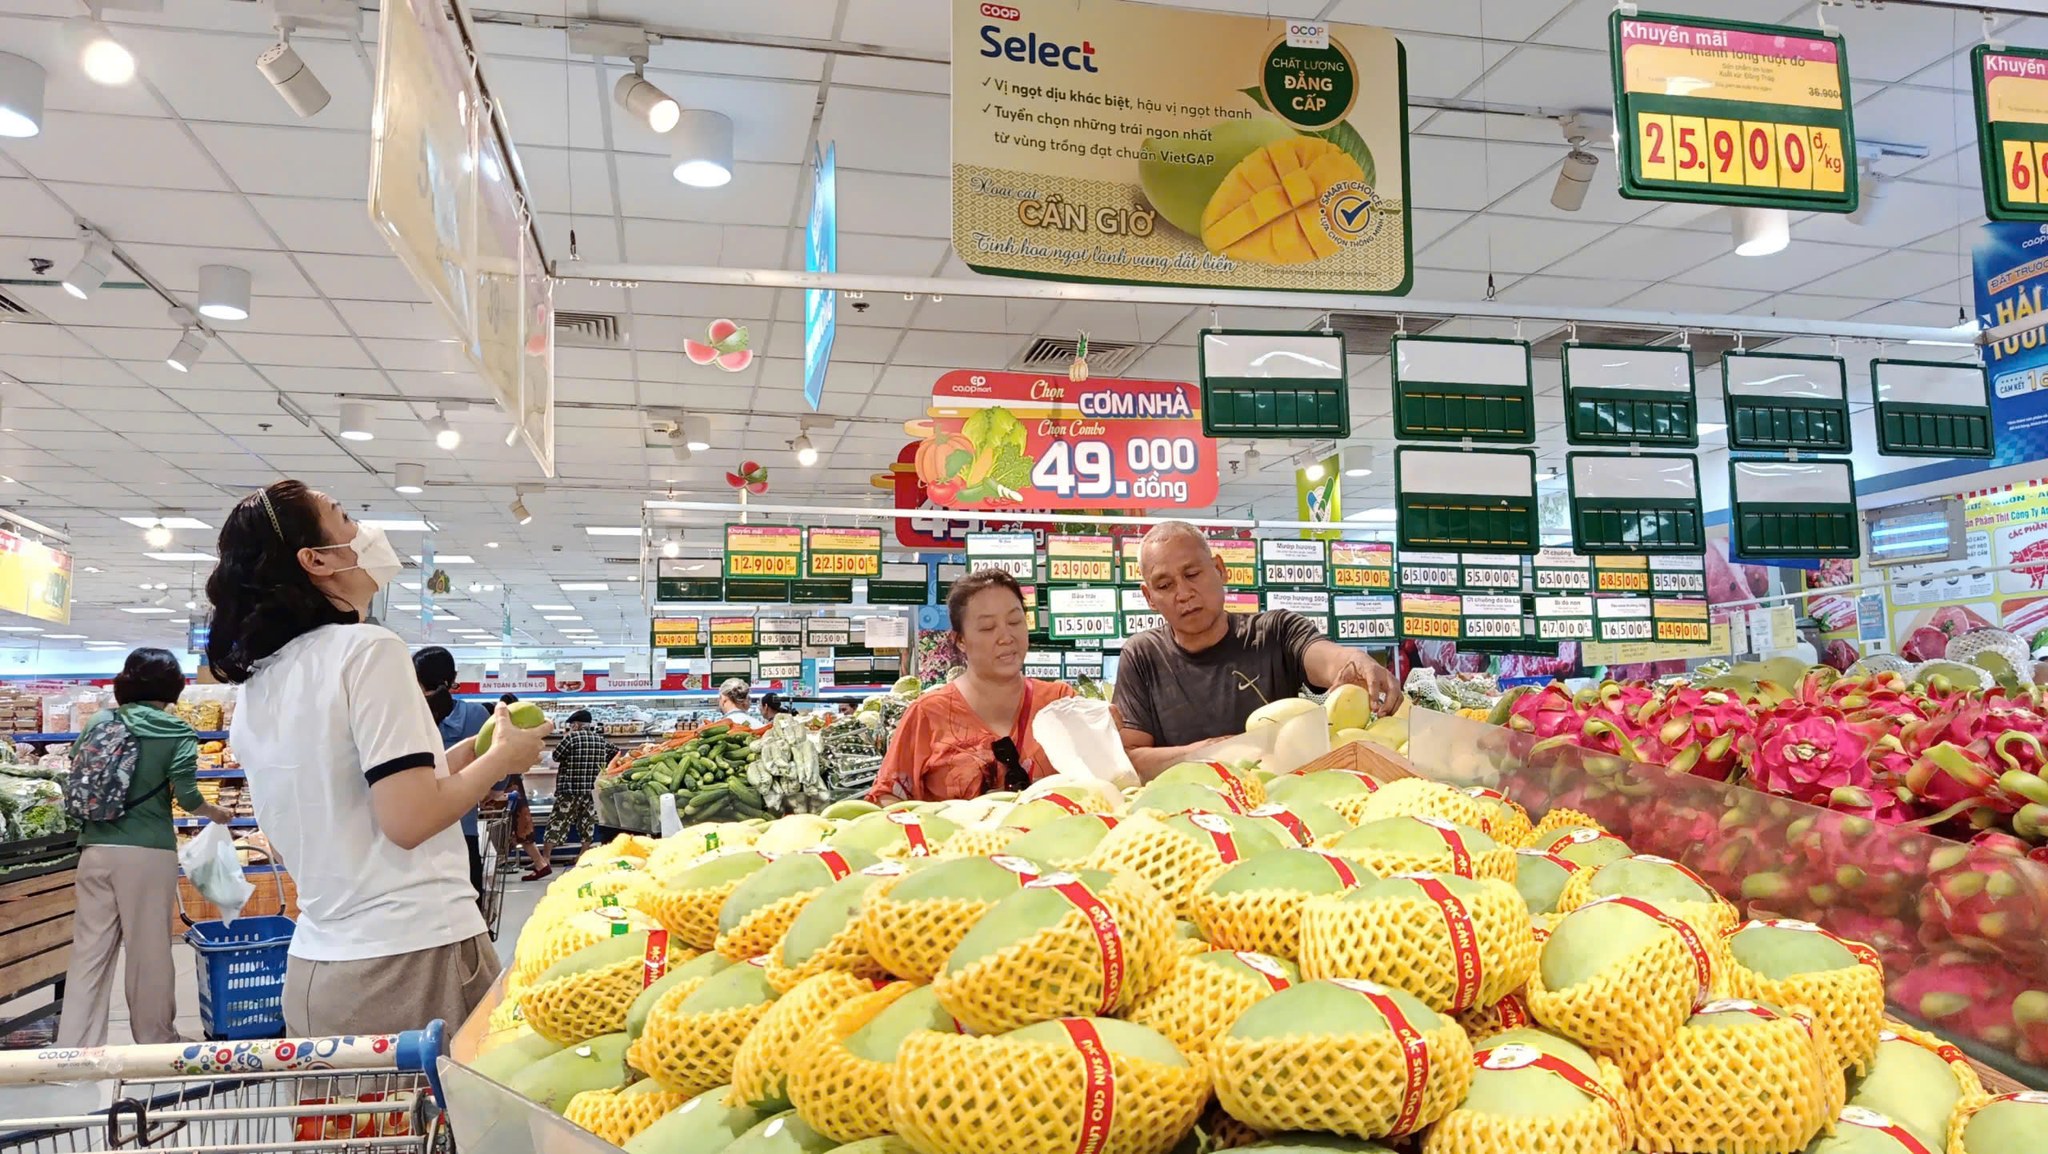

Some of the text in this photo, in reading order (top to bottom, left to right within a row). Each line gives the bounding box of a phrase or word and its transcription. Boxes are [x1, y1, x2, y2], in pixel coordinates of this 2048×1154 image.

[981, 5, 1019, 19] COOP
[1291, 25, 1323, 36] OCOP
[1623, 22, 1728, 47] Khuyến mãi
[980, 25, 1098, 73] Select
[1733, 48, 1759, 64] long
[1272, 57, 1344, 72] CHẤT LƯỢNG
[1986, 55, 2046, 77] Khuyến
[1284, 71, 1332, 91] ĐẲNG
[994, 79, 1252, 119] Vị ngọt dịu khác biệt, hậu vị ngọt thanh
[1292, 94, 1326, 111] CẤP
[994, 105, 1212, 142] Tuyển chọn những trái ngon nhất
[994, 131, 1010, 144] từ
[1014, 135, 1046, 152] vùng
[1090, 144, 1112, 159] đạt
[1116, 147, 1155, 161] chuẩn
[1160, 150, 1214, 165] VietGAP
[1646, 123, 1805, 173] 25.900
[1322, 181, 1383, 208] SMART CHOICE
[1018, 193, 1156, 237] CẦN GIỜ
[1031, 379, 1064, 400] Chọn
[1080, 387, 1191, 416] CƠM NHÀ
[1038, 419, 1106, 437] Chọn Combo
[1133, 470, 1187, 502] đồng
[734, 557, 784, 571] 12.900
[815, 556, 865, 571] 22.500
[1269, 567, 1312, 579] 28.900
[1338, 570, 1379, 583] 23.500
[1403, 569, 1446, 582] 65.000
[1467, 571, 1509, 583] 55.000
[1540, 573, 1579, 585] 65.000
[1655, 576, 1694, 587] 35.900
[1059, 619, 1102, 632] 15.500
[1341, 622, 1384, 634] 52.900
[1406, 618, 1448, 633] 32.500
